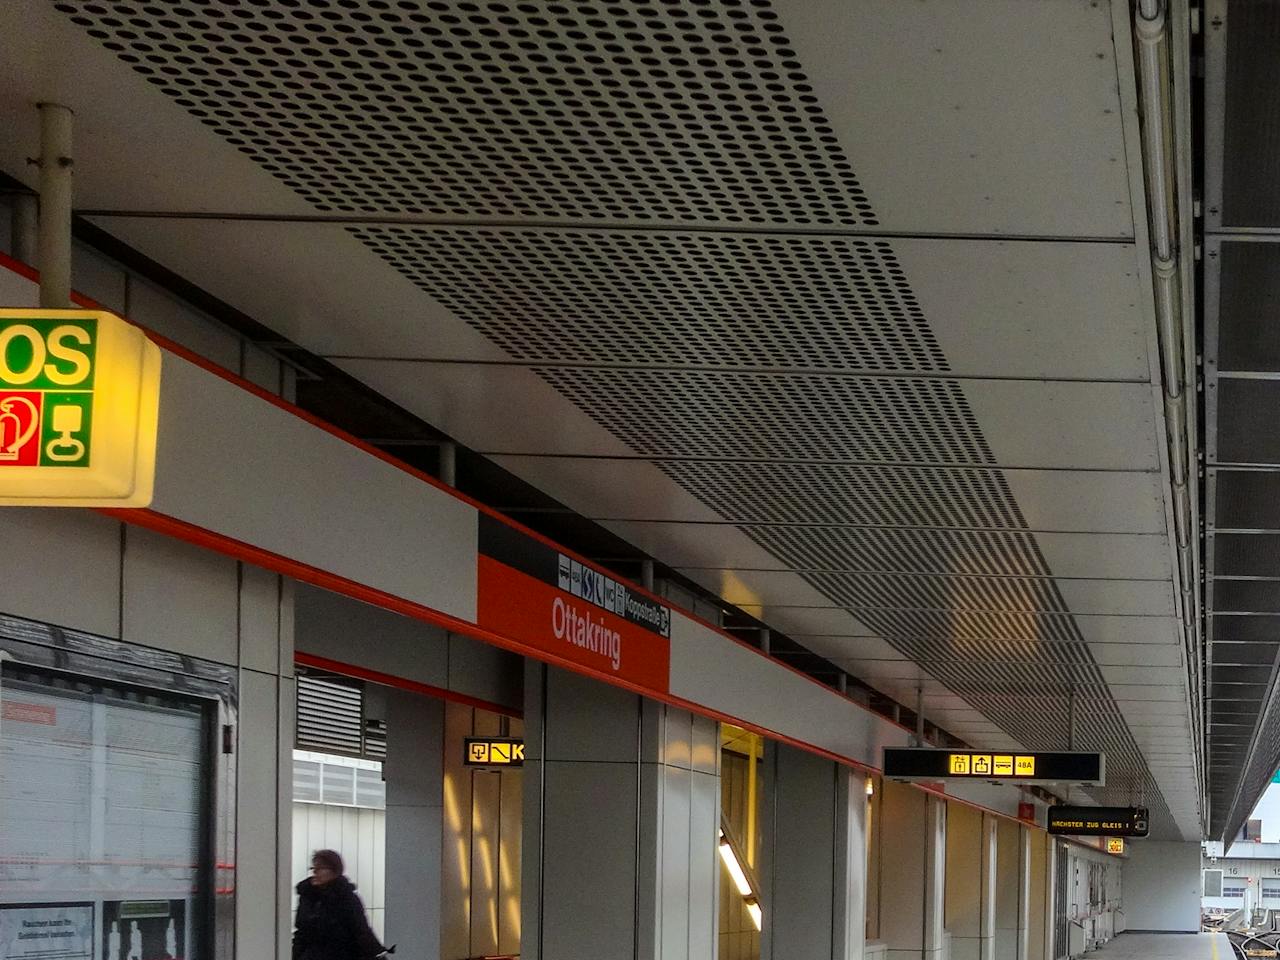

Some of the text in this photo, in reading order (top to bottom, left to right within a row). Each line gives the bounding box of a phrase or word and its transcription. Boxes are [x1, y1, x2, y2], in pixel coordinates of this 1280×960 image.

[625, 592, 661, 626] Koppstraße
[551, 596, 622, 671] Ottakring
[1017, 761, 1033, 769] 48A
